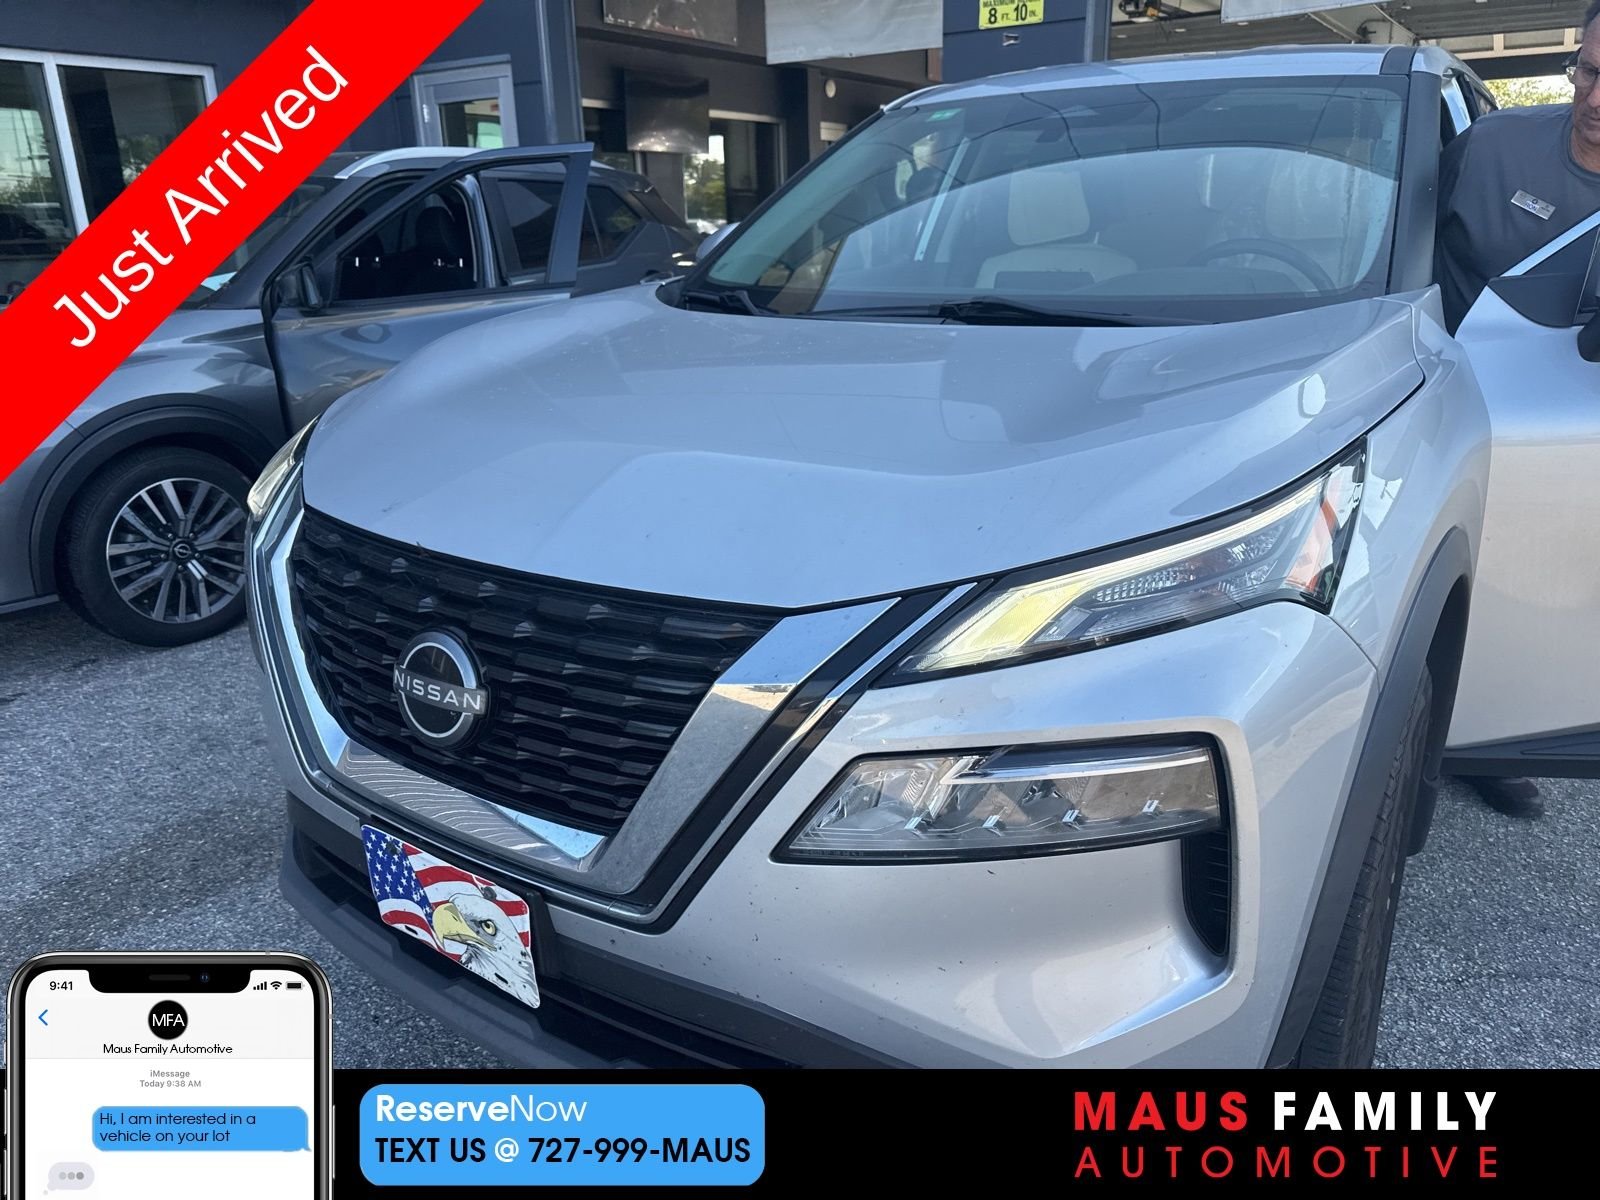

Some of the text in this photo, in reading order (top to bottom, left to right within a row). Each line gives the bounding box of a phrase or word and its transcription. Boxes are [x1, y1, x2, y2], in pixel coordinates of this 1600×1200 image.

[988, 7, 998, 24] 8
[1013, 3, 1028, 21] 10
[394, 669, 481, 711] NISSAN
